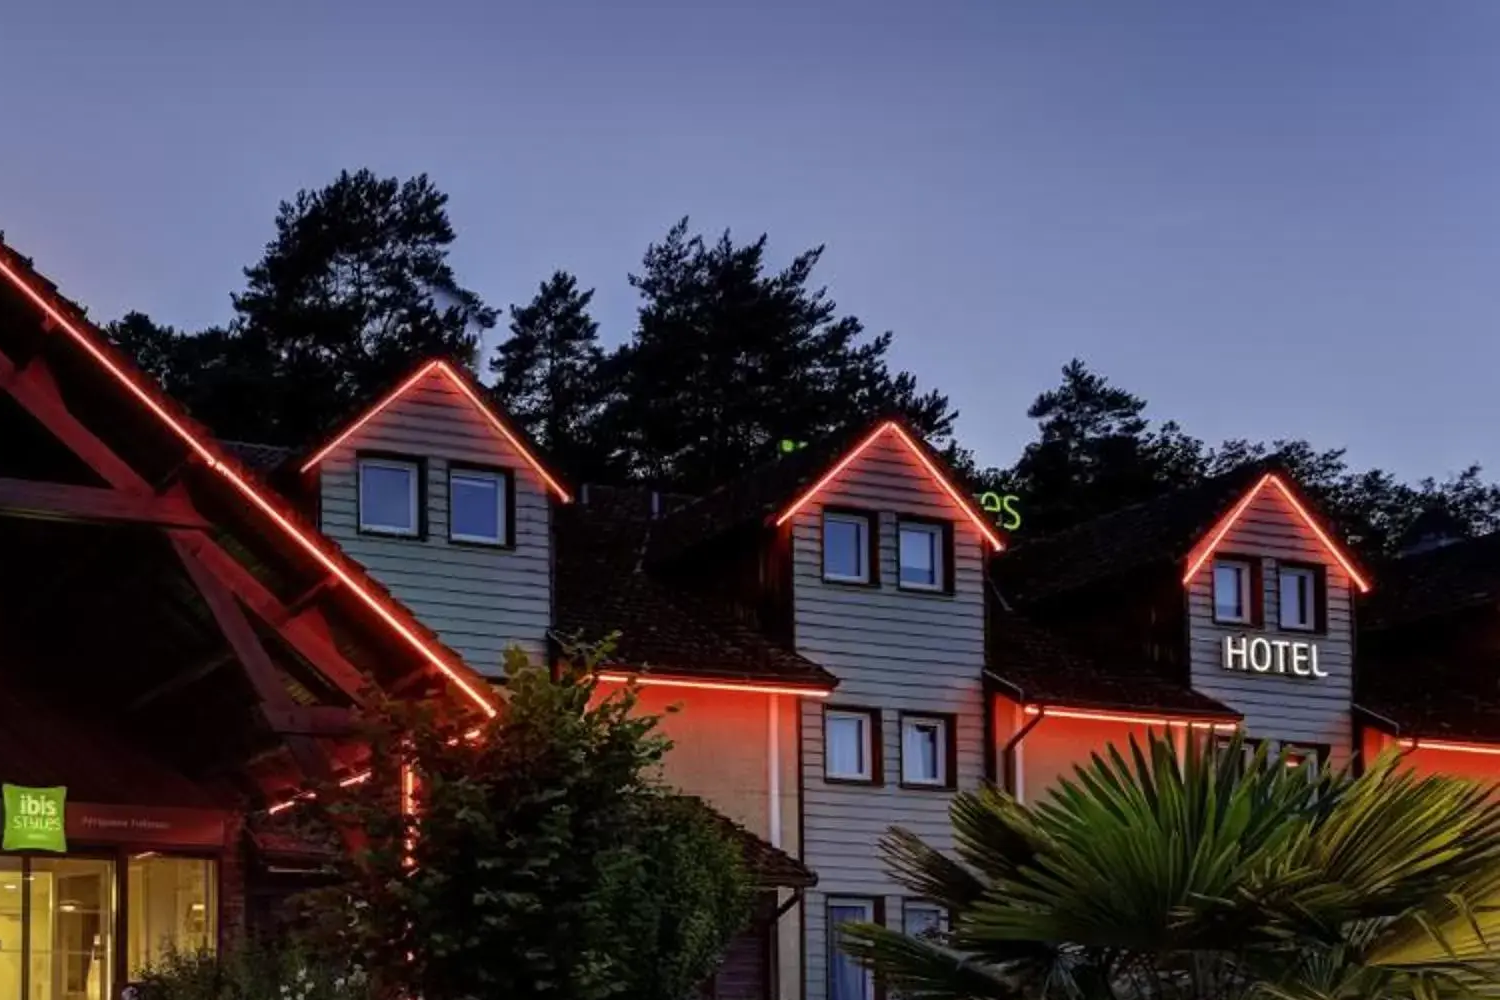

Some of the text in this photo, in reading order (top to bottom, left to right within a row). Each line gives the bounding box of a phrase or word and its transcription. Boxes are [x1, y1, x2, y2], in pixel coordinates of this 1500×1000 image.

[980, 491, 1021, 531] es
[1225, 635, 1329, 677] HOTEL
[19, 793, 58, 816] ibis
